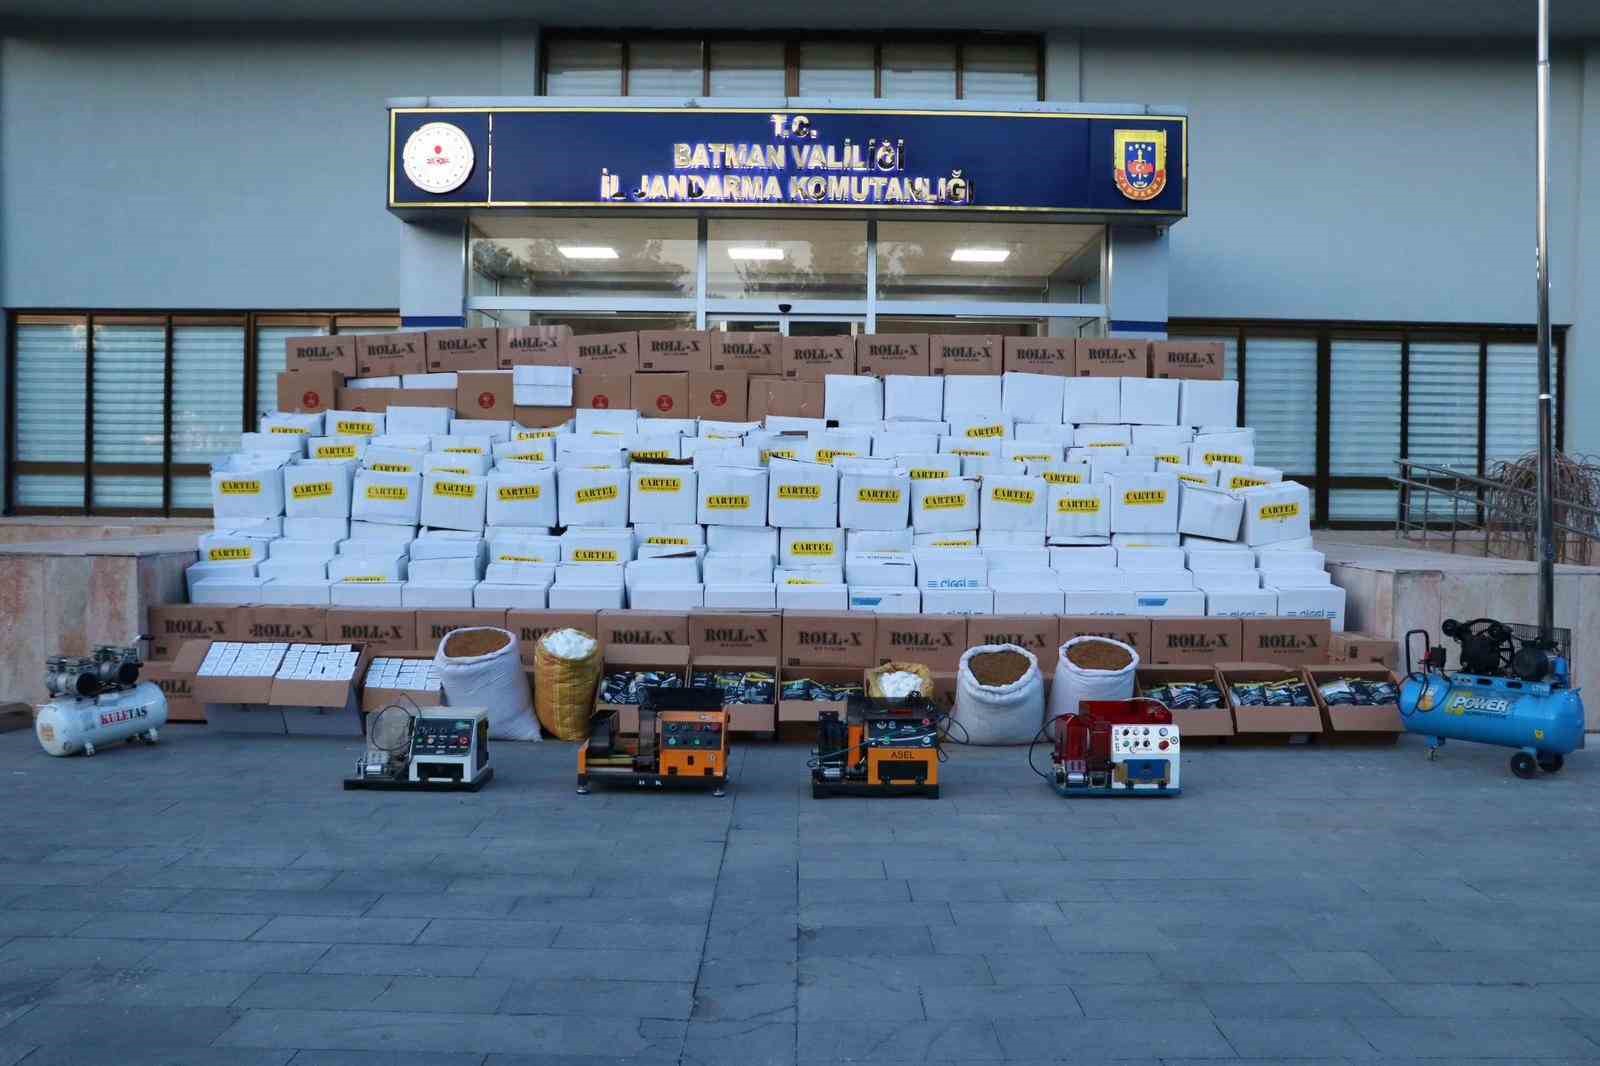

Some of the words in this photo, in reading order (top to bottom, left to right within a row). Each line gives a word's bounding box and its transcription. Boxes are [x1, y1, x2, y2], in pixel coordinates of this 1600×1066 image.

[770, 114, 816, 138] T.C.
[674, 144, 784, 169] BATMAN
[792, 139, 904, 171] VALİLİĞİ
[600, 168, 628, 200] İL
[634, 174, 782, 200] JANDARMA
[792, 170, 972, 203] KOMUTANLIĞI
[438, 338, 488, 351] ROLL-X
[510, 337, 558, 349] ROLL-X
[651, 340, 700, 352] ROLL-X
[297, 346, 344, 359] ROLL-X
[368, 343, 415, 356] ROLL-X
[579, 342, 628, 357] ROLL-X
[722, 343, 772, 356] ROLL-X
[794, 348, 844, 360] ROLL-X
[868, 343, 920, 357] ROLL-X
[942, 346, 992, 358] ROLL-X
[1016, 348, 1066, 360] ROLL-X
[1088, 348, 1137, 360] ROLL-X
[1168, 352, 1216, 365] ROLL-X
[338, 422, 374, 432] CARTEL
[967, 426, 1002, 437] CARTEL
[318, 446, 354, 456] CARTEL
[1204, 454, 1241, 464] CARTEL
[910, 470, 946, 479] CARTEL
[1044, 472, 1080, 482] CARTEL
[222, 480, 259, 490] CARTEL
[294, 484, 332, 494] CARTEL
[436, 483, 474, 494] CARTEL
[640, 479, 679, 488] CARTEL
[368, 486, 406, 496] CARTEL
[500, 487, 538, 496] CARTEL
[578, 487, 615, 498] CARTEL
[780, 486, 818, 496] CARTEL
[860, 489, 899, 500] CARTEL
[994, 488, 1032, 500] CARTEL
[1126, 492, 1164, 502] CARTEL
[708, 496, 747, 505] CARTEL
[924, 496, 962, 506] CARTEL
[1060, 500, 1098, 510] CARTEL
[1261, 504, 1297, 516] CARTEL
[211, 549, 250, 558] CARTEL
[793, 544, 832, 553] CARTEL
[576, 551, 615, 560] CARTEL
[164, 620, 225, 635] ROLL-X
[252, 624, 313, 638] ROLL-X
[341, 624, 402, 638] ROLL-X
[611, 630, 674, 644] ROLL-X
[704, 628, 767, 642] ROLL-X
[798, 631, 862, 646] ROLL-X
[890, 632, 954, 646] ROLL-X
[1166, 632, 1229, 648] ROLL-X
[1258, 634, 1320, 648] ROLL-X
[1452, 696, 1508, 712] POWER
[890, 751, 915, 760] ASEL
